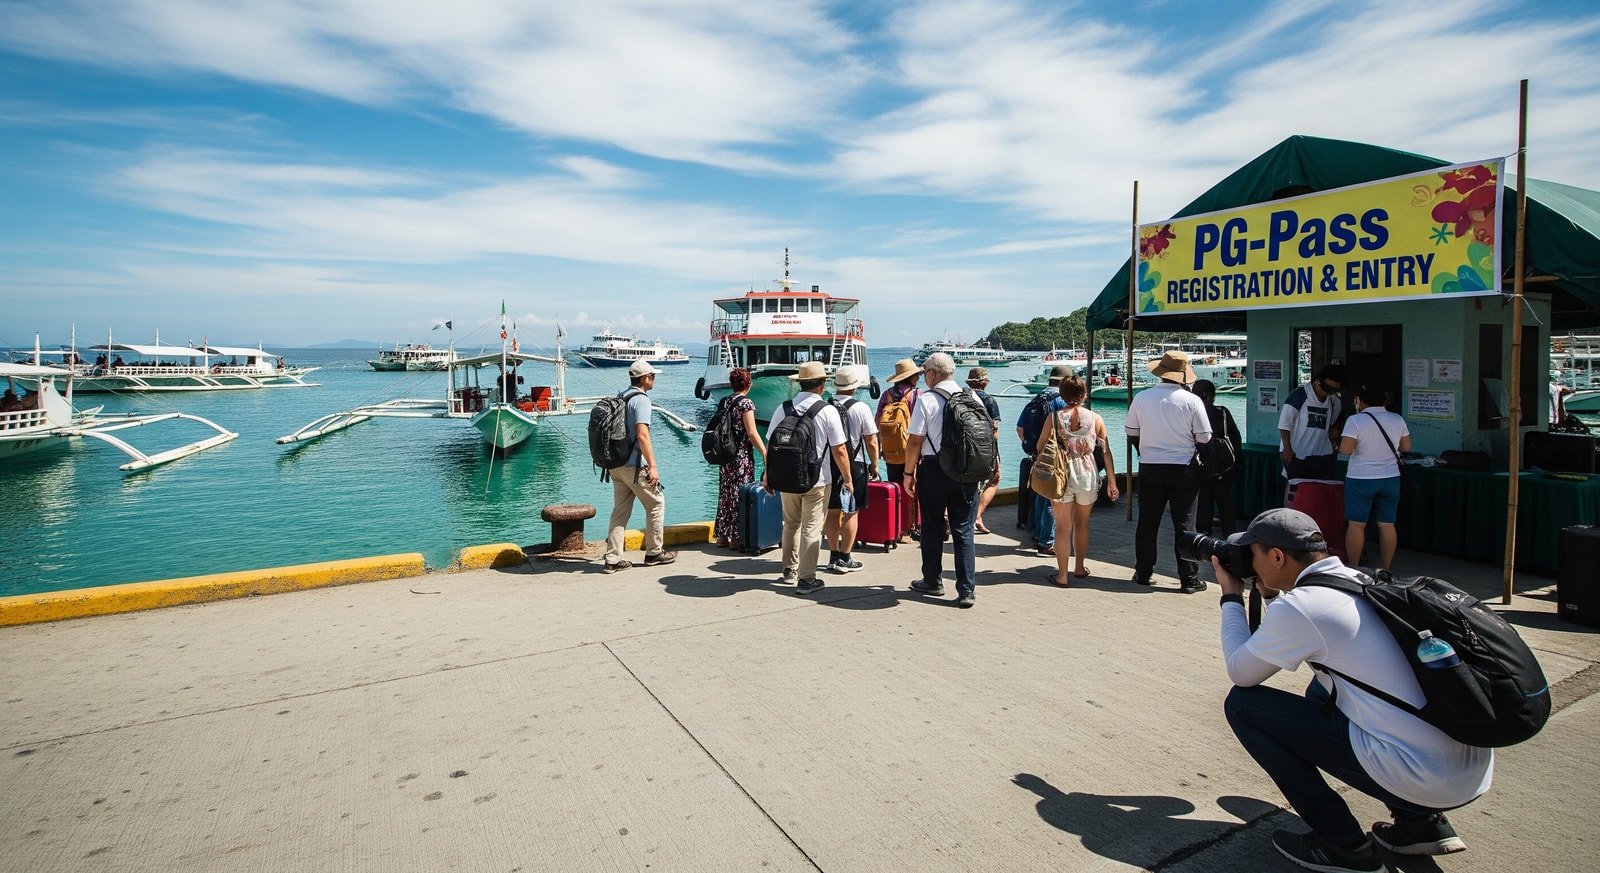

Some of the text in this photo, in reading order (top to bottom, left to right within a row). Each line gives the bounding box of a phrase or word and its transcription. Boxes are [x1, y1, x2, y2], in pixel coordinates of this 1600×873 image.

[1193, 208, 1390, 271] PG-Pass
[1166, 252, 1436, 305] REGISTRATION & ENTRY
